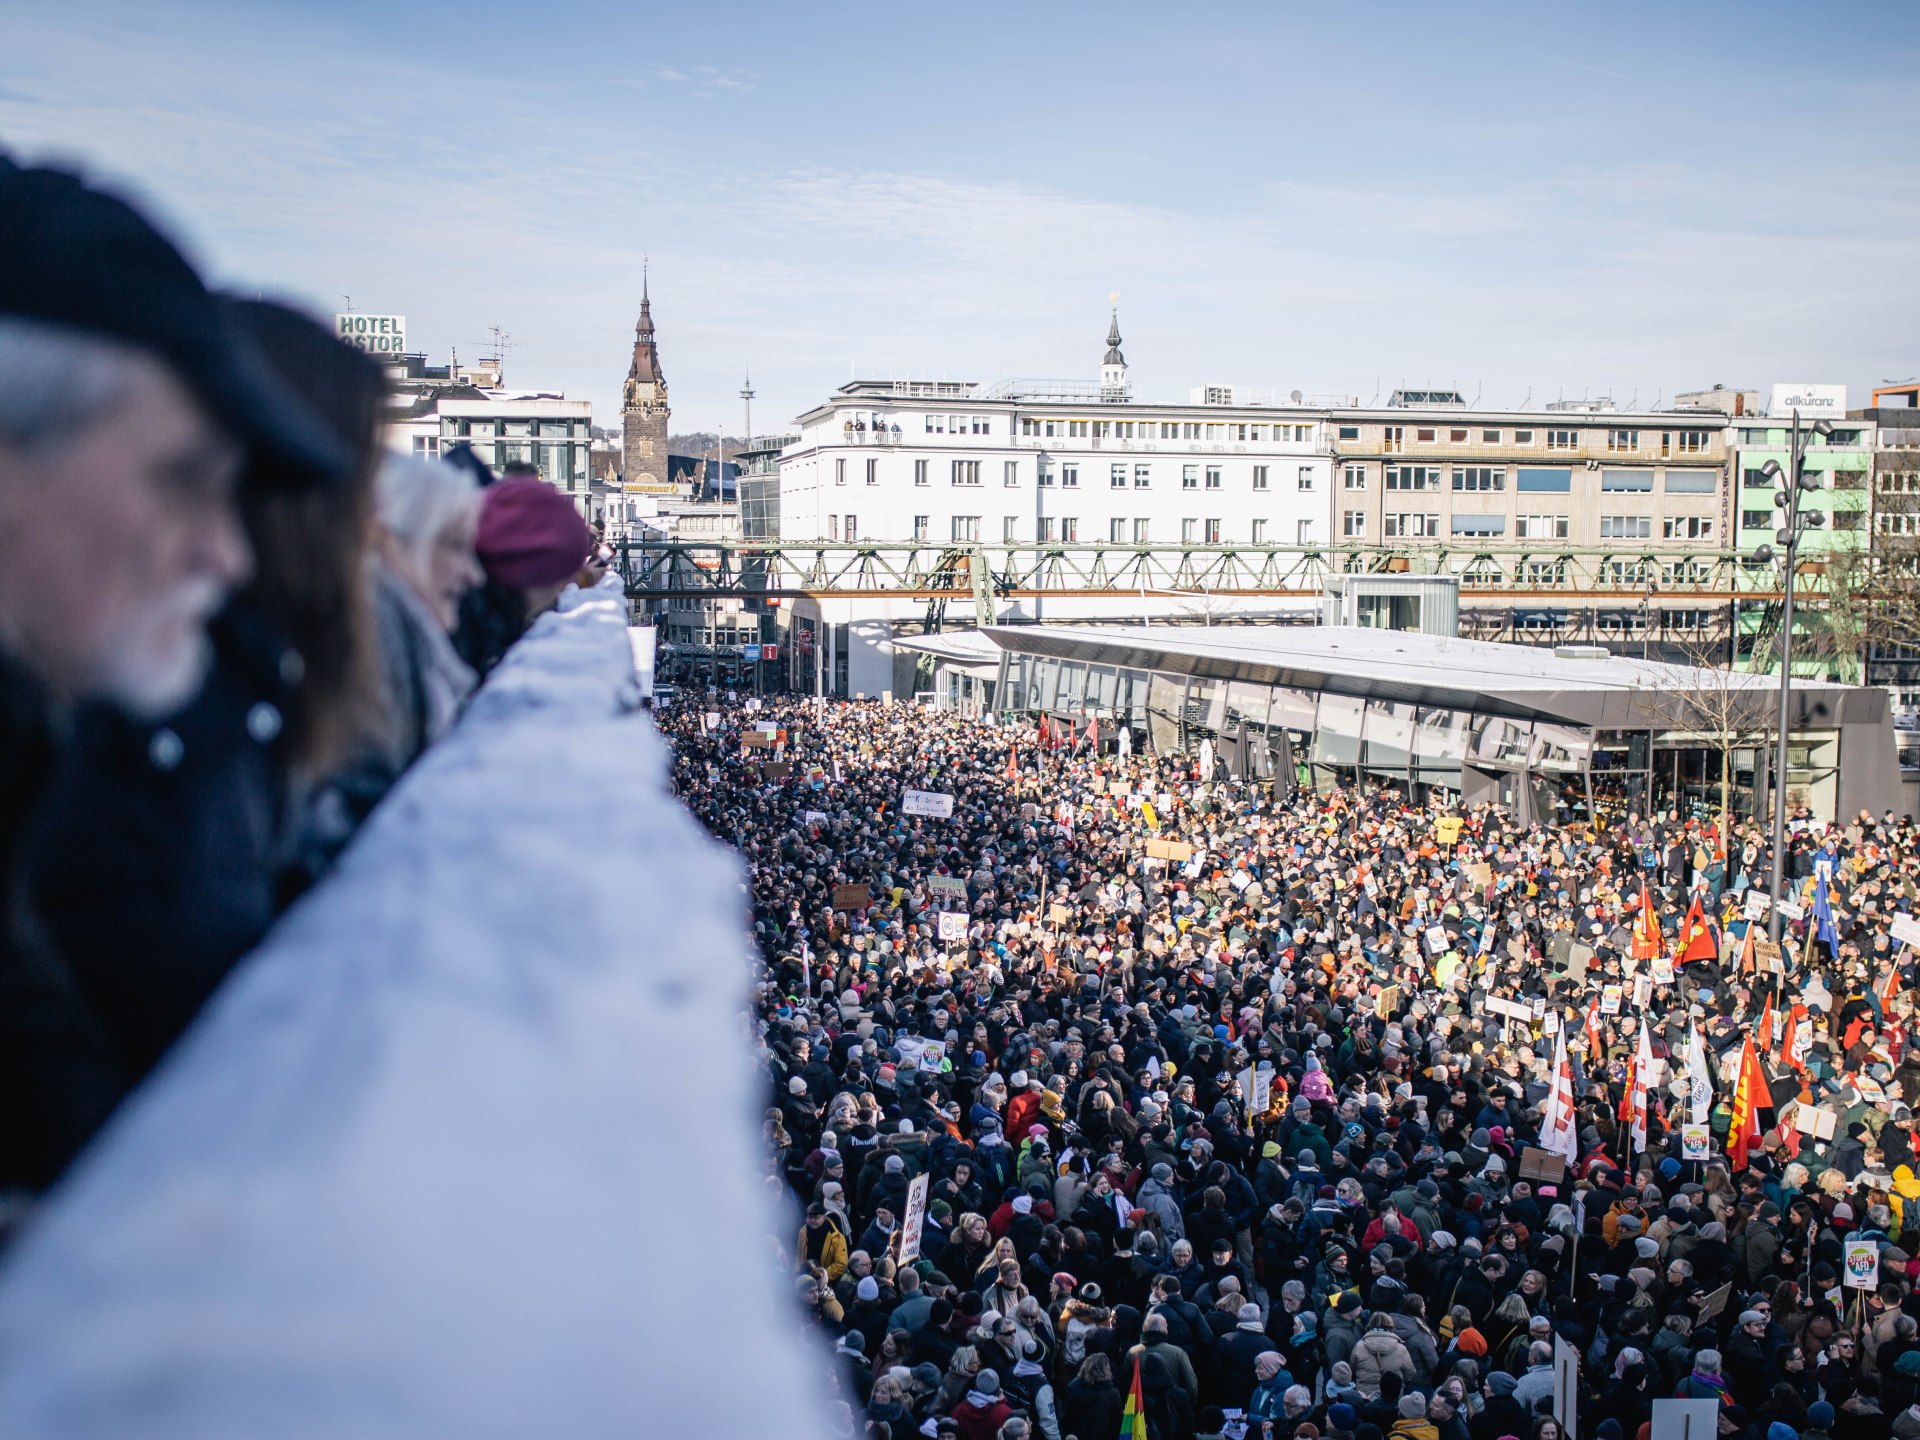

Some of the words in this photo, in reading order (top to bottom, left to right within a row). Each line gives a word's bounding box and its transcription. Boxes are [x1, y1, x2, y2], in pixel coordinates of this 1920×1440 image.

[340, 316, 403, 334] HOTEL
[1784, 395, 1834, 406] allkuranz
[1690, 1141, 1703, 1149] AFD
[1849, 1253, 1872, 1263] STOPPT
[1855, 1260, 1870, 1272] AFD
